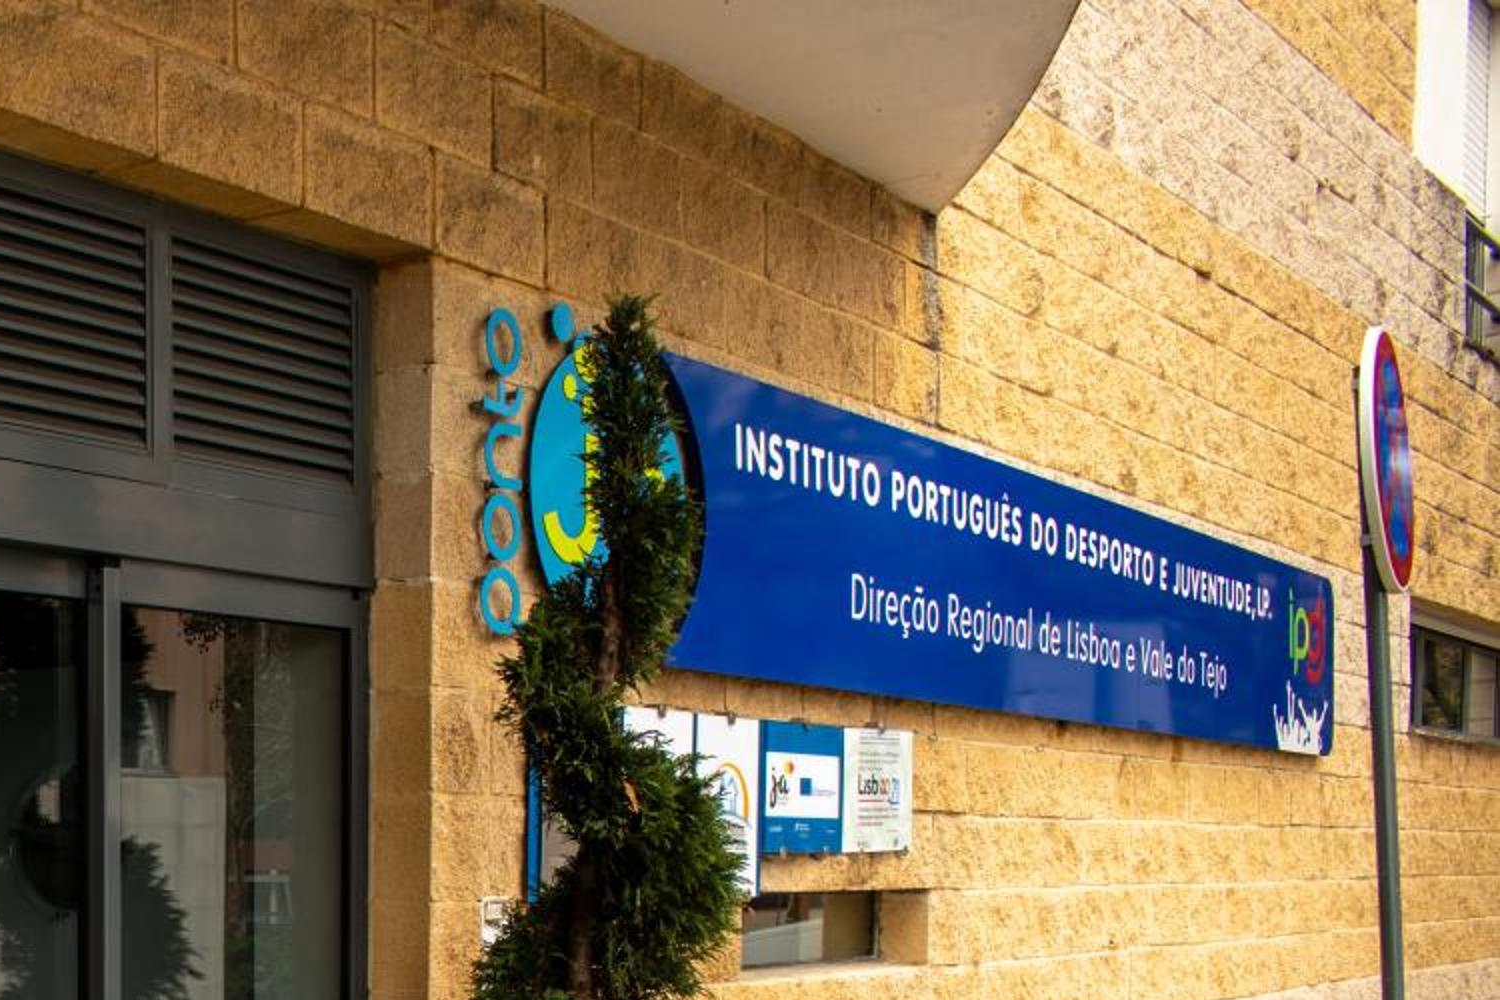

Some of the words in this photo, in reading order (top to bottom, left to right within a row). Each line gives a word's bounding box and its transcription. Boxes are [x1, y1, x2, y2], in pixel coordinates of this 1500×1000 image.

[734, 422, 881, 508] INSTITUTO
[891, 470, 1023, 547] PORTUGUÊS
[1030, 512, 1059, 557] DO
[1065, 523, 1155, 587] DESPORTO
[1159, 557, 1168, 591] E
[851, 573, 940, 639] Direção
[947, 593, 1033, 654] Regional
[1038, 611, 1061, 657] de
[1067, 620, 1121, 669] Lisboa
[1125, 643, 1136, 673] e
[1139, 637, 1173, 680] Vale
[1177, 645, 1195, 684] do
[1200, 652, 1228, 698] Tejo
